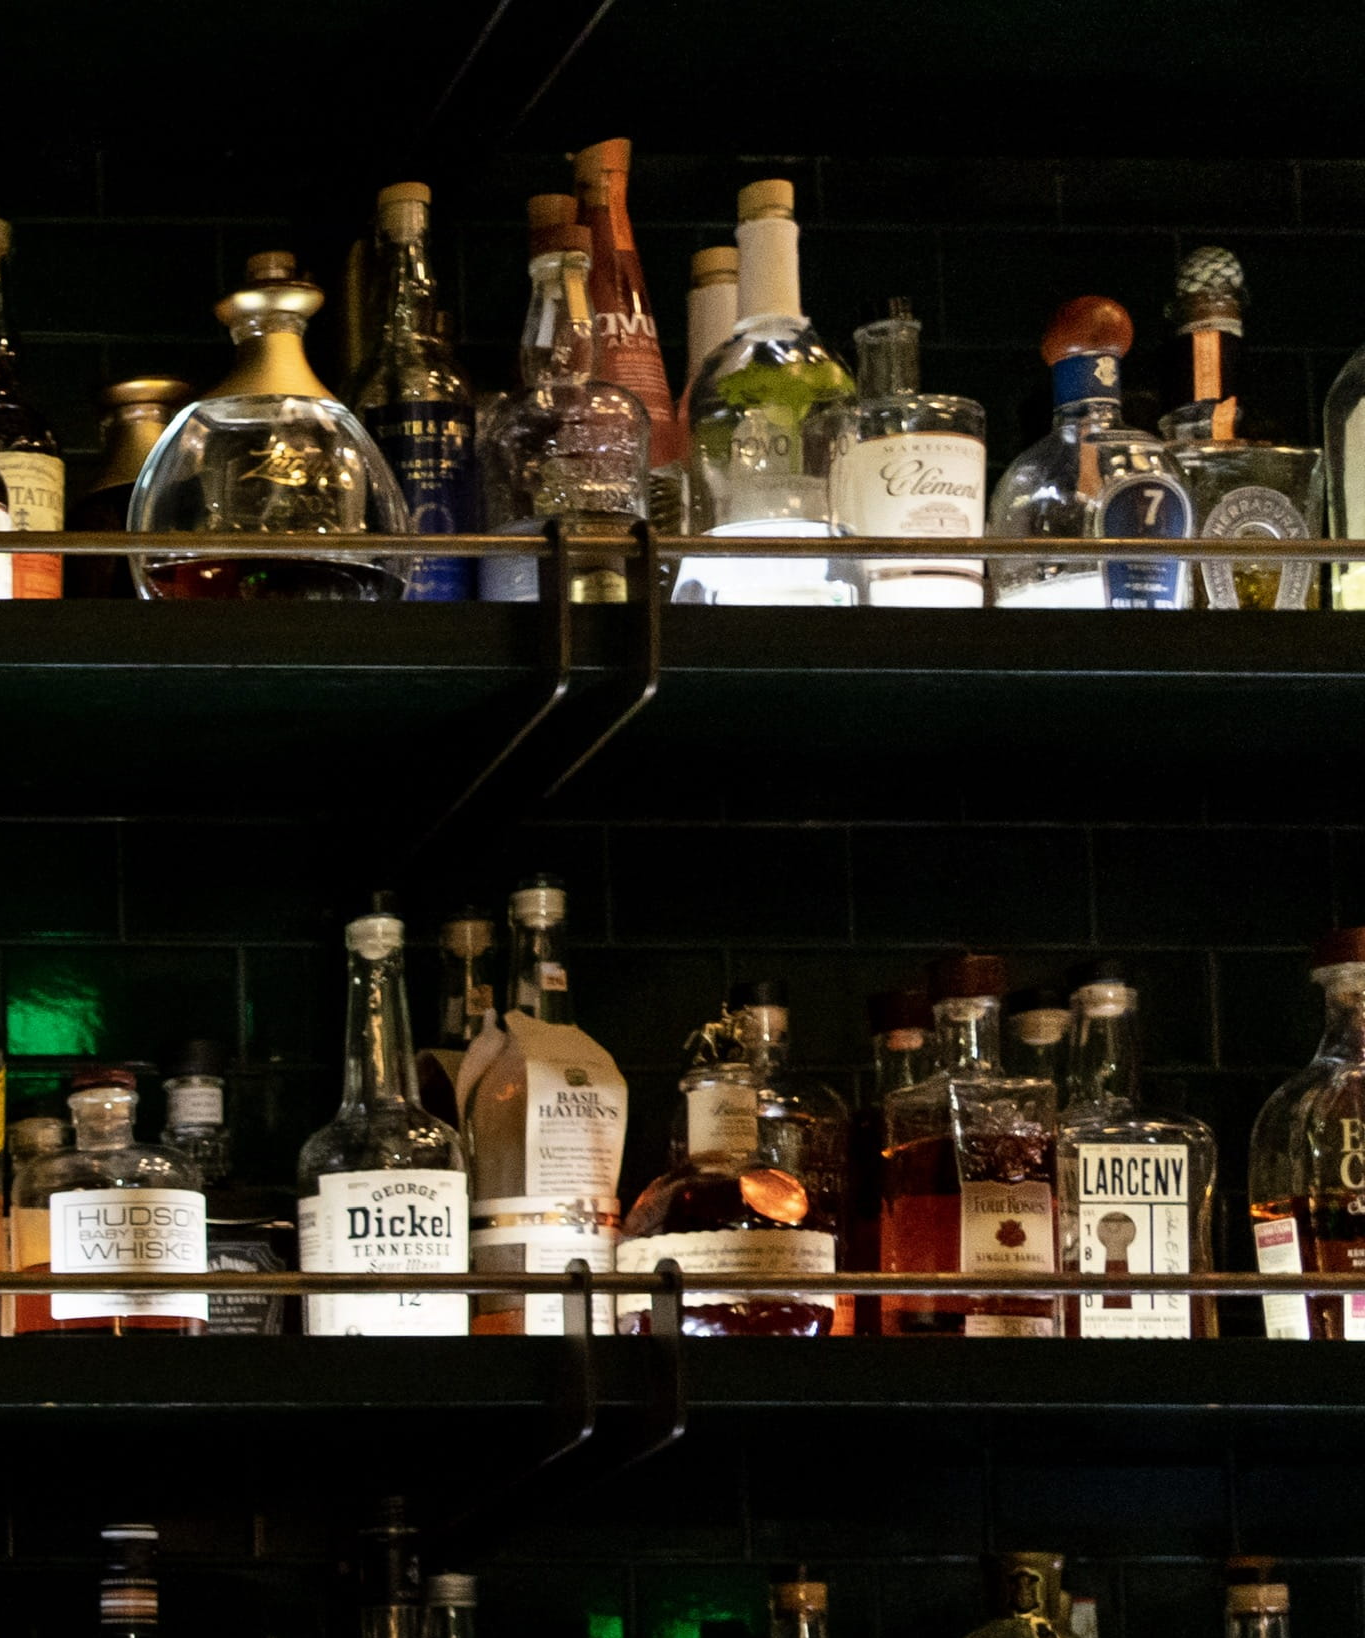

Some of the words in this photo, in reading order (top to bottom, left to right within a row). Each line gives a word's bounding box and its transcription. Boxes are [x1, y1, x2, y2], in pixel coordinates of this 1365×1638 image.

[879, 458, 979, 501] Clément
[1142, 488, 1165, 526] 7
[556, 1091, 600, 1104] BASIL
[538, 1105, 618, 1120] HAYDEN'S
[1082, 1157, 1184, 1196] LARCENY
[371, 1183, 438, 1202] GEORGE
[347, 1205, 452, 1240] Dickel
[79, 1229, 126, 1241] BABY
[80, 1242, 199, 1261] WHISKE
